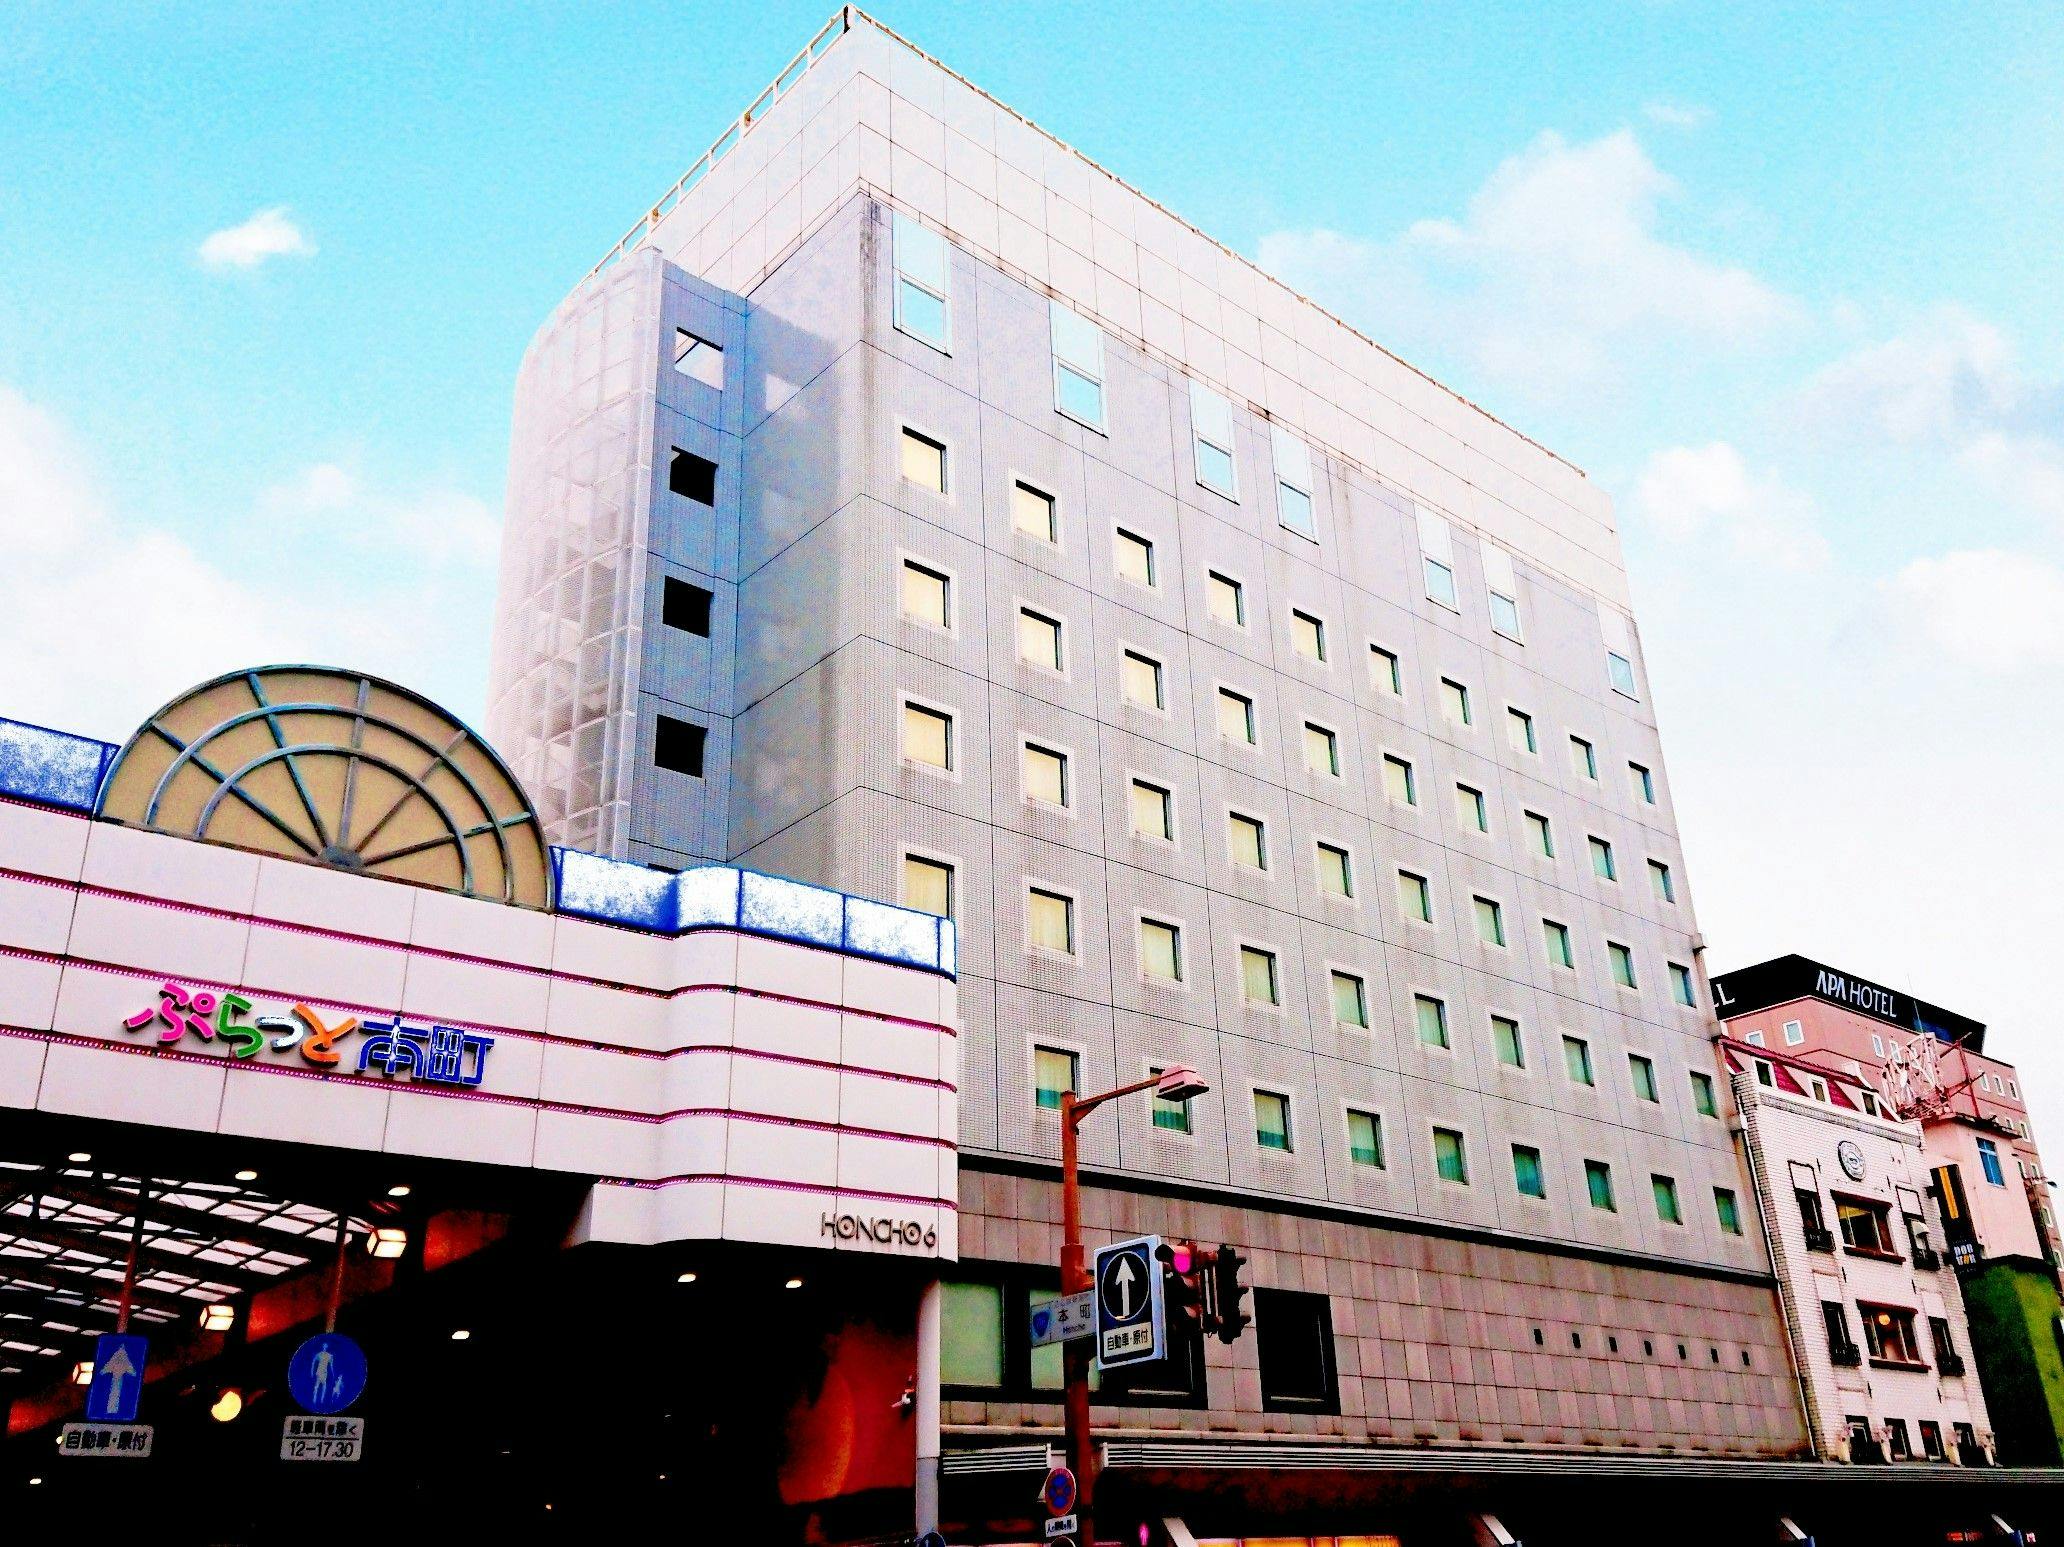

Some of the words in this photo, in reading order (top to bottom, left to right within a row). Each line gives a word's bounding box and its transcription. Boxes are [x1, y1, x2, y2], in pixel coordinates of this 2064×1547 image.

[1816, 970, 1846, 1000] APA
[1850, 981, 1897, 1018] HOTEL
[122, 982, 495, 1087] ぷらっと南町
[821, 1211, 922, 1246] HONCHO
[923, 1223, 937, 1249] 6
